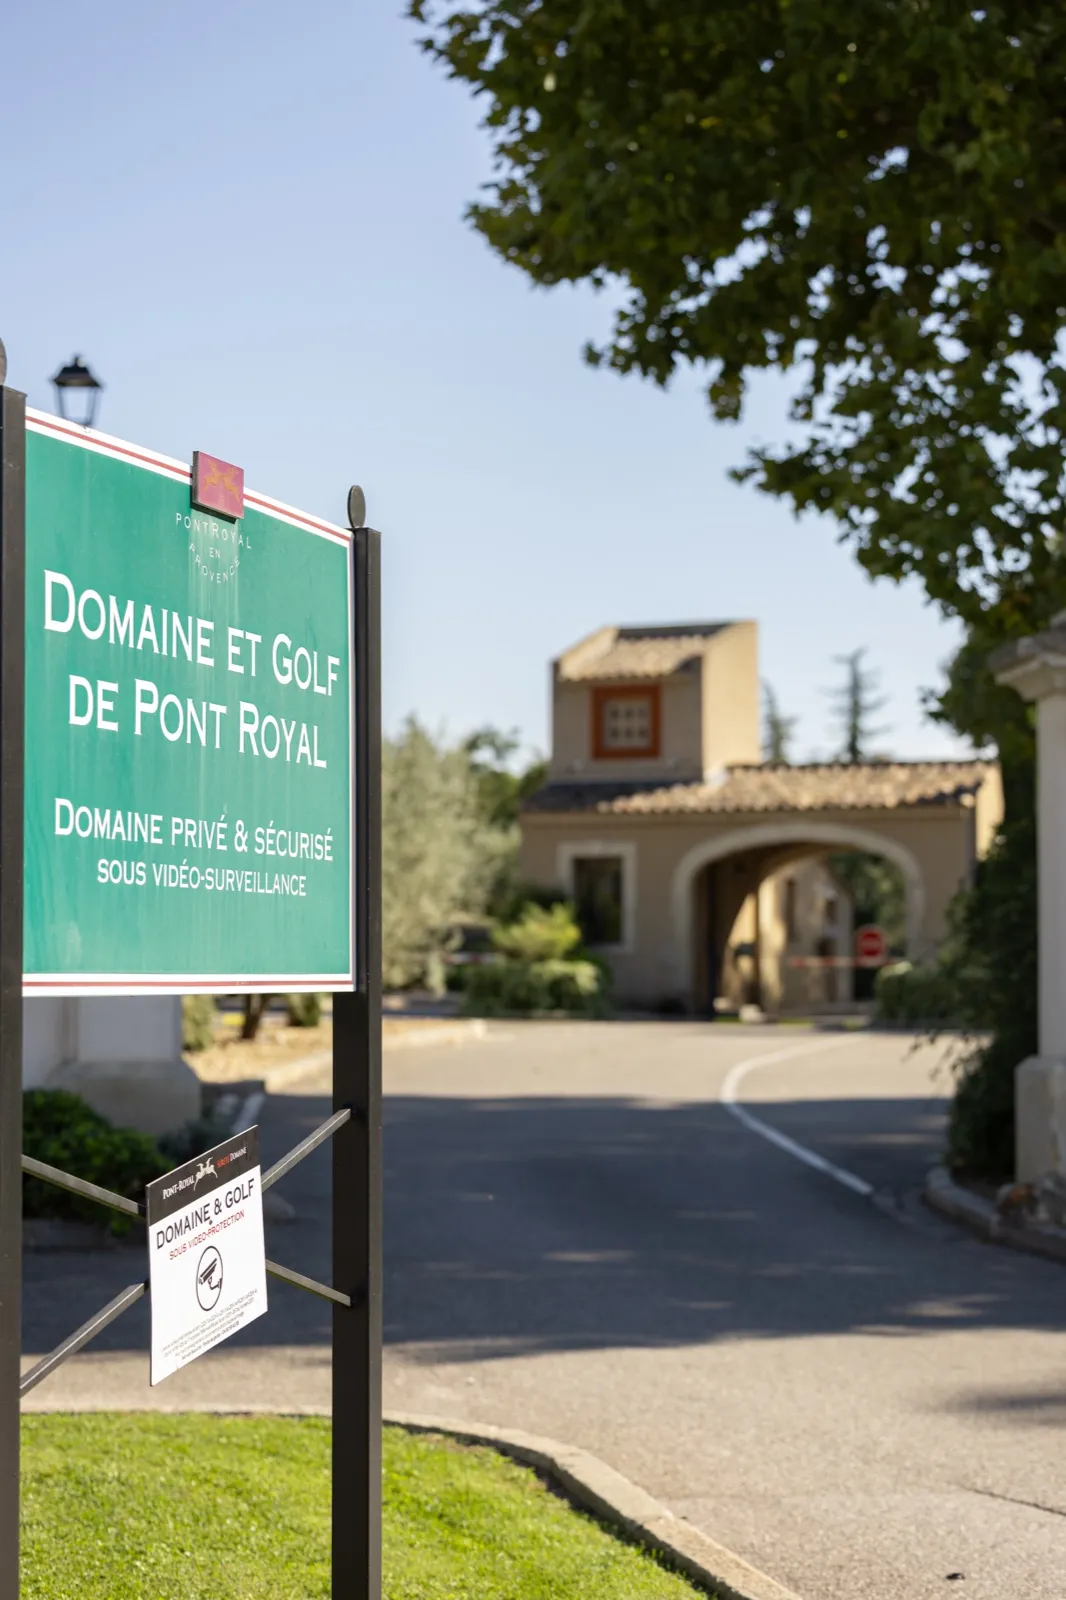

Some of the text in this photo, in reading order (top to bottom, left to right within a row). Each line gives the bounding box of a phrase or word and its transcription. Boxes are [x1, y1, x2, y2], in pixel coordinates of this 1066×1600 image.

[189, 543, 240, 583] PROVENCE
[209, 547, 221, 558] EN
[43, 569, 340, 696] DOMAINE ET GOLF
[68, 674, 328, 768] DE PONT ROYAL
[54, 797, 333, 862] DOMAINE PRIVÉ & SÉCURISÉ
[97, 858, 307, 897] SOUS VIDÉO-SURVEILLANCE
[162, 1175, 195, 1200] PONT-ROYAL
[156, 1178, 254, 1250] DOMAINE & GOLF
[169, 1243, 187, 1260] SOUS
